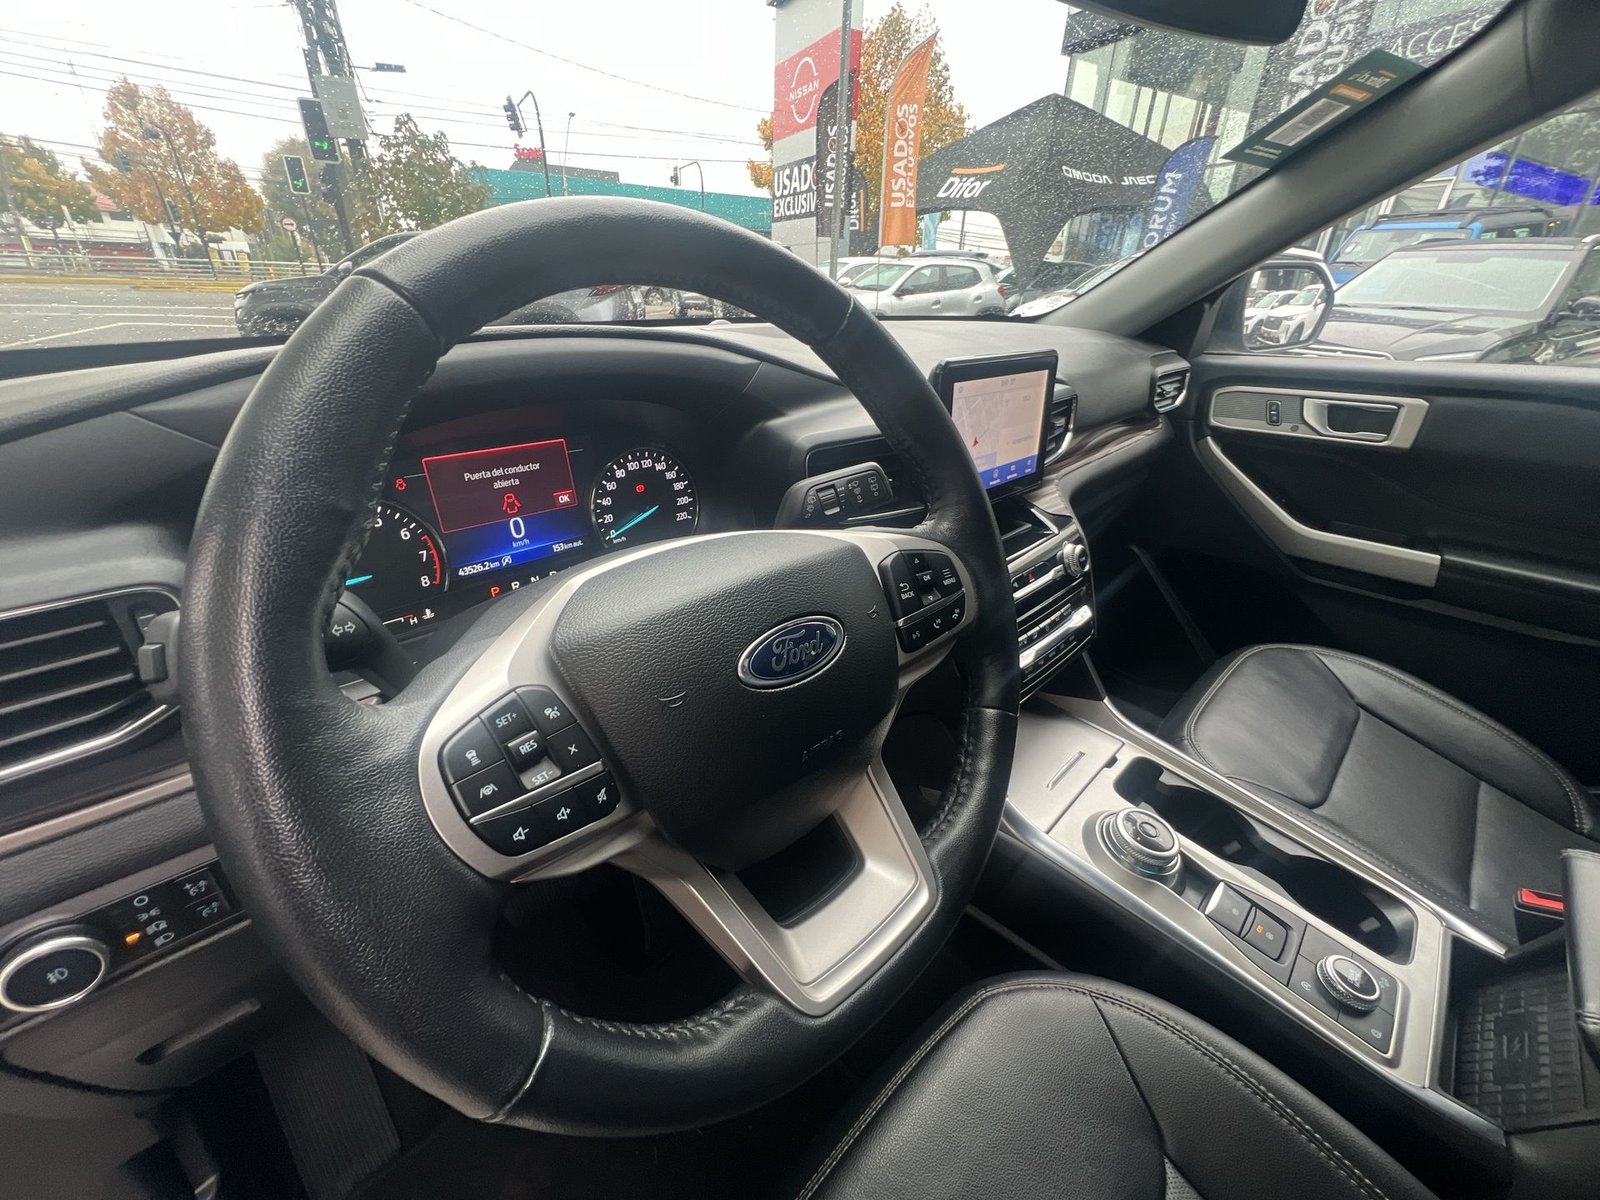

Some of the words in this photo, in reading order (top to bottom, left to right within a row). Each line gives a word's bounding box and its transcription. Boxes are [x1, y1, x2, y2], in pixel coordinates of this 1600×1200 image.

[789, 79, 819, 100] NISSAN
[890, 103, 909, 208] USADOS
[906, 103, 918, 208] EXCLUSIVOS
[1062, 165, 1113, 184] OMODA
[936, 177, 992, 198] Difor
[627, 461, 640, 471] 100
[641, 459, 652, 468] 120
[654, 461, 666, 471] 140
[463, 470, 492, 481] Puerta
[491, 467, 504, 477] del
[504, 463, 540, 475] conductor
[615, 469, 626, 479] 80
[664, 470, 677, 480] 160
[493, 478, 520, 489] abierta
[606, 481, 617, 491] 60
[672, 481, 684, 491] 180
[558, 494, 570, 503] OK
[601, 496, 612, 506] 40
[676, 496, 689, 506] 200
[603, 513, 614, 523] 20
[676, 511, 688, 521] 220
[400, 527, 411, 540] 6
[509, 517, 526, 540] 0
[512, 538, 530, 548] km/h
[613, 535, 627, 544] km/h
[552, 542, 564, 552] 153
[564, 542, 573, 550] km
[419, 550, 427, 562] 7
[458, 561, 490, 576] 43526.2
[490, 560, 500, 568] km
[420, 575, 430, 587] 8
[943, 577, 956, 586] MENU
[491, 586, 500, 598] P
[512, 581, 520, 590] R
[901, 591, 915, 600] BACK
[409, 617, 418, 625] H
[771, 629, 824, 671] Ford
[495, 712, 517, 728] SET+
[519, 739, 538, 755] RES
